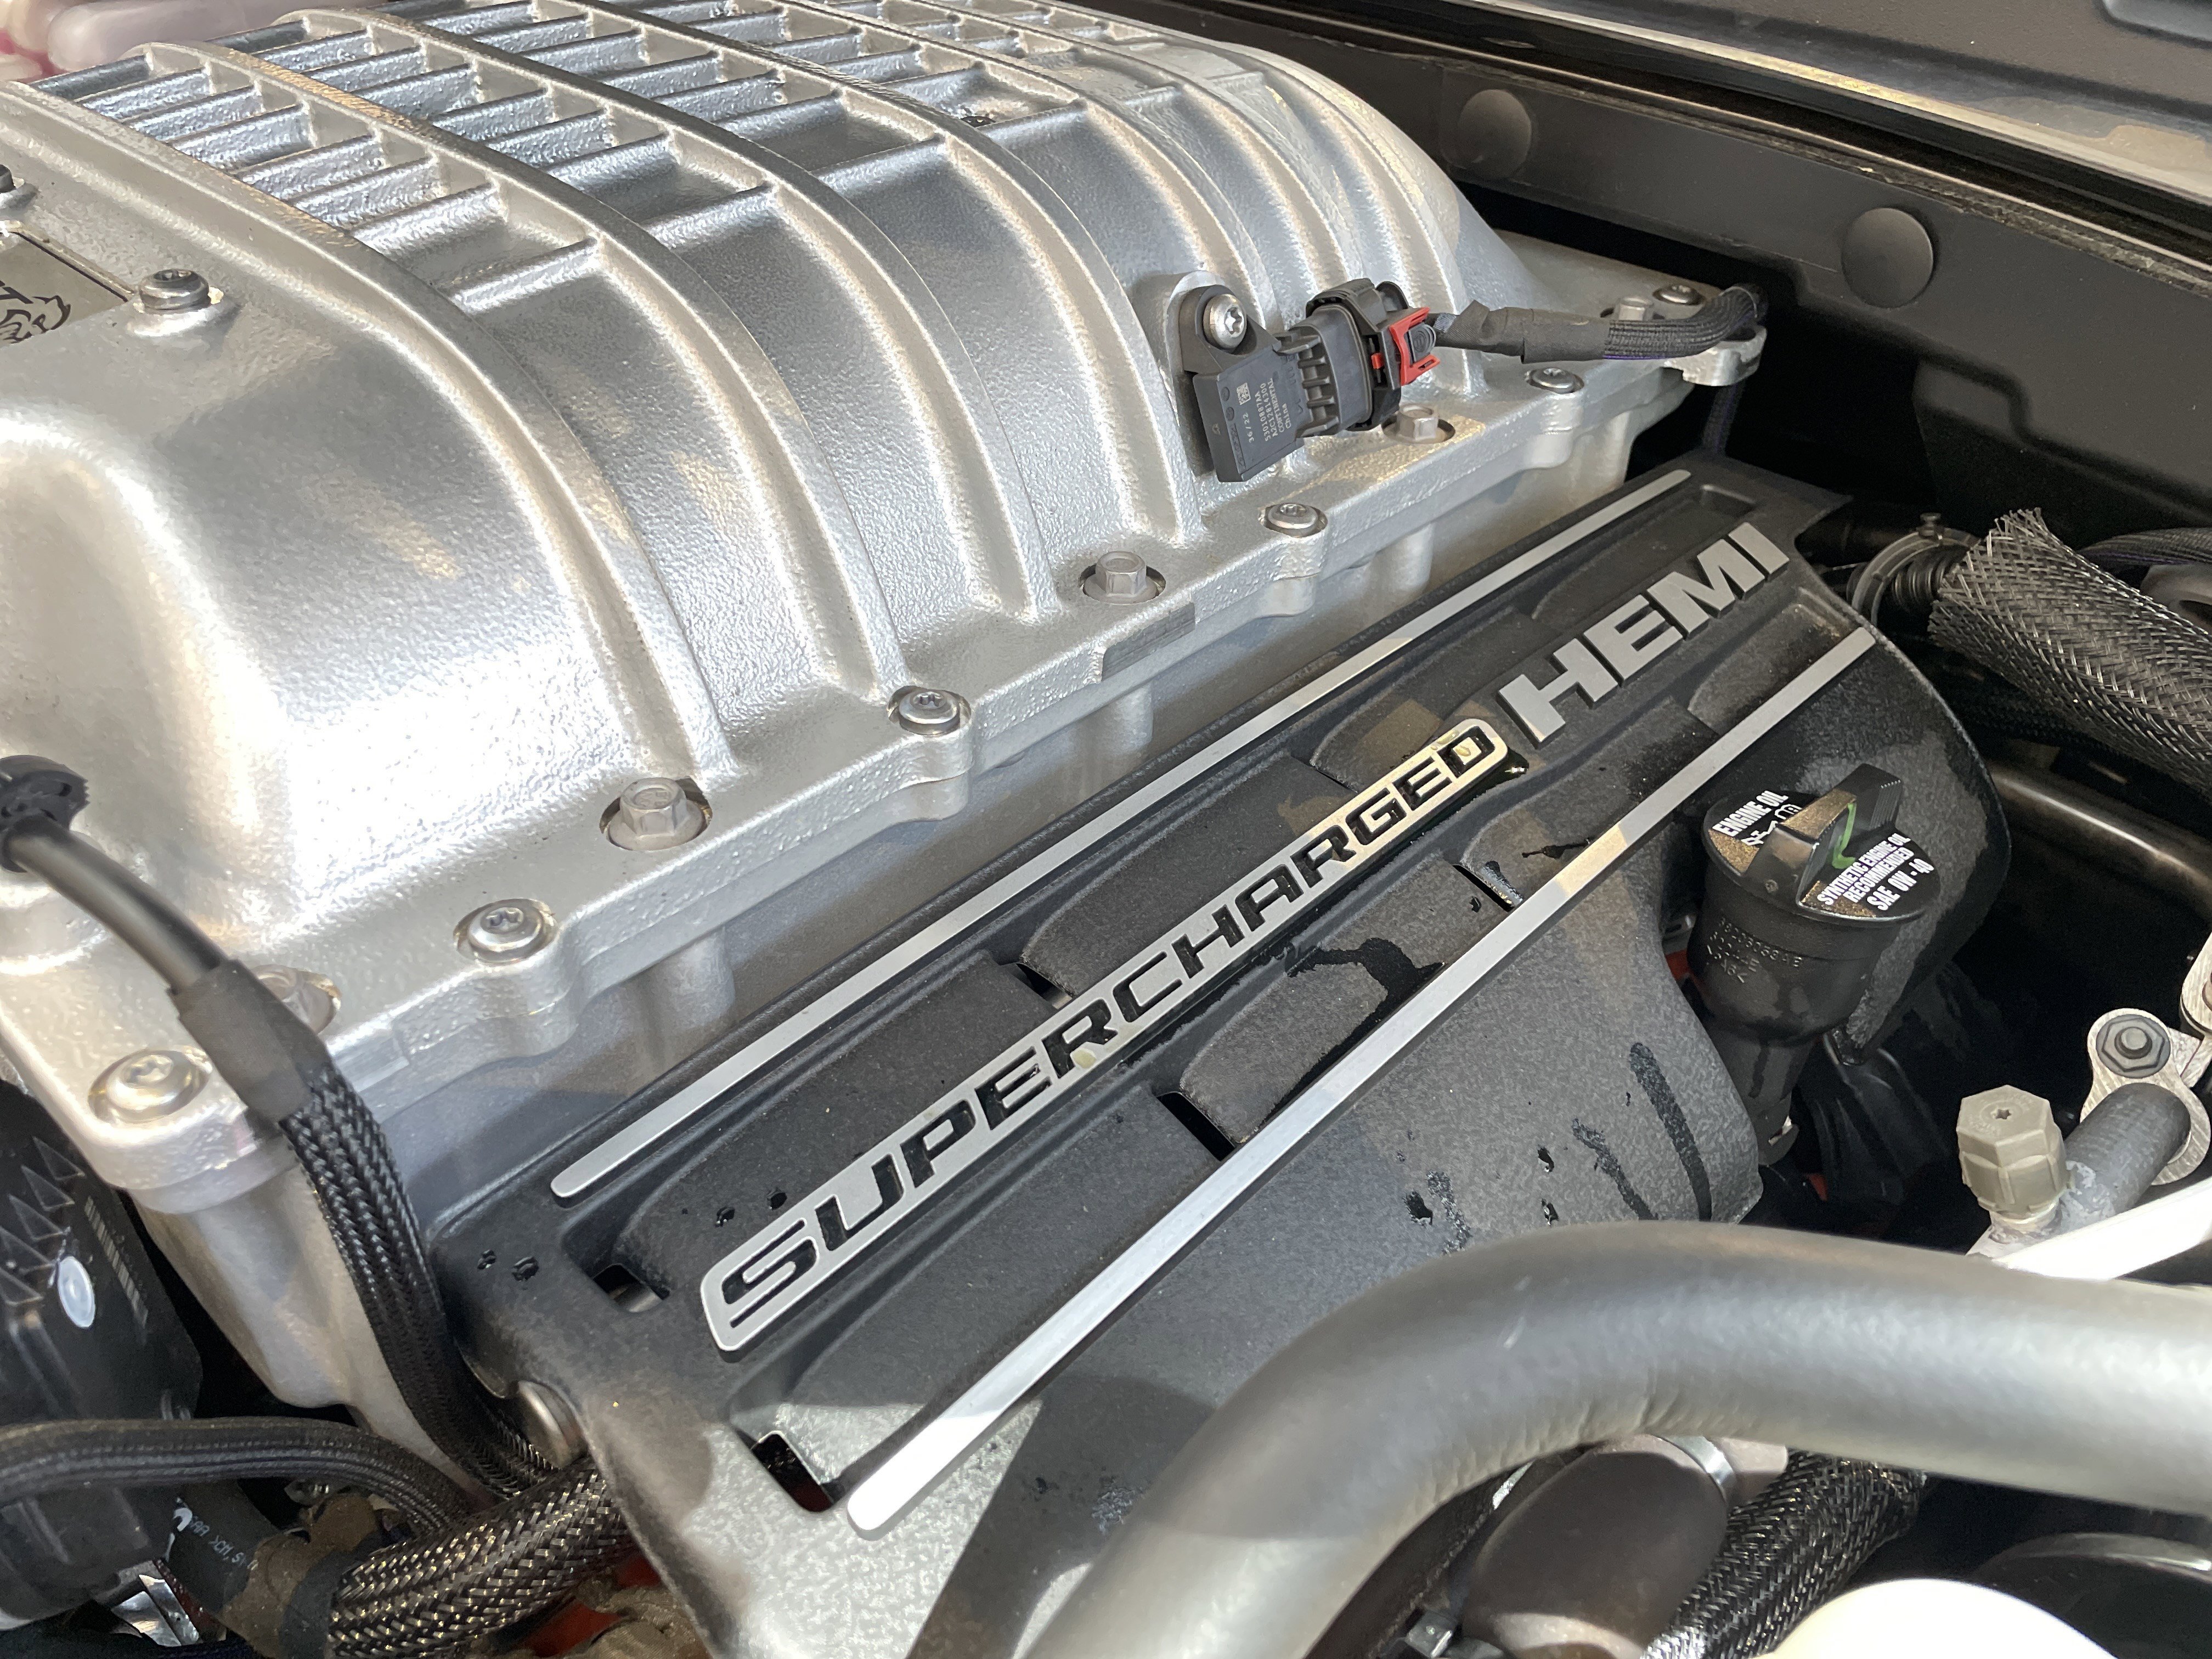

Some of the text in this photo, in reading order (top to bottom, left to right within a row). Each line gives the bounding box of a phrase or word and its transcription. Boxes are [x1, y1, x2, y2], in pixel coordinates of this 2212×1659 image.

[1267, 378, 1285, 433] CONTINENTAL
[1282, 403, 1291, 429] China
[1498, 522, 1790, 744] HEMI
[1712, 790, 1789, 837] ENGINE OIL
[1816, 833, 1911, 905] SYNTHETIC ENGINE OIL
[1842, 847, 1915, 904] RECOMMENDED
[1866, 885, 1901, 911] SAE
[720, 722, 1498, 1330] SUPERCHARGED
